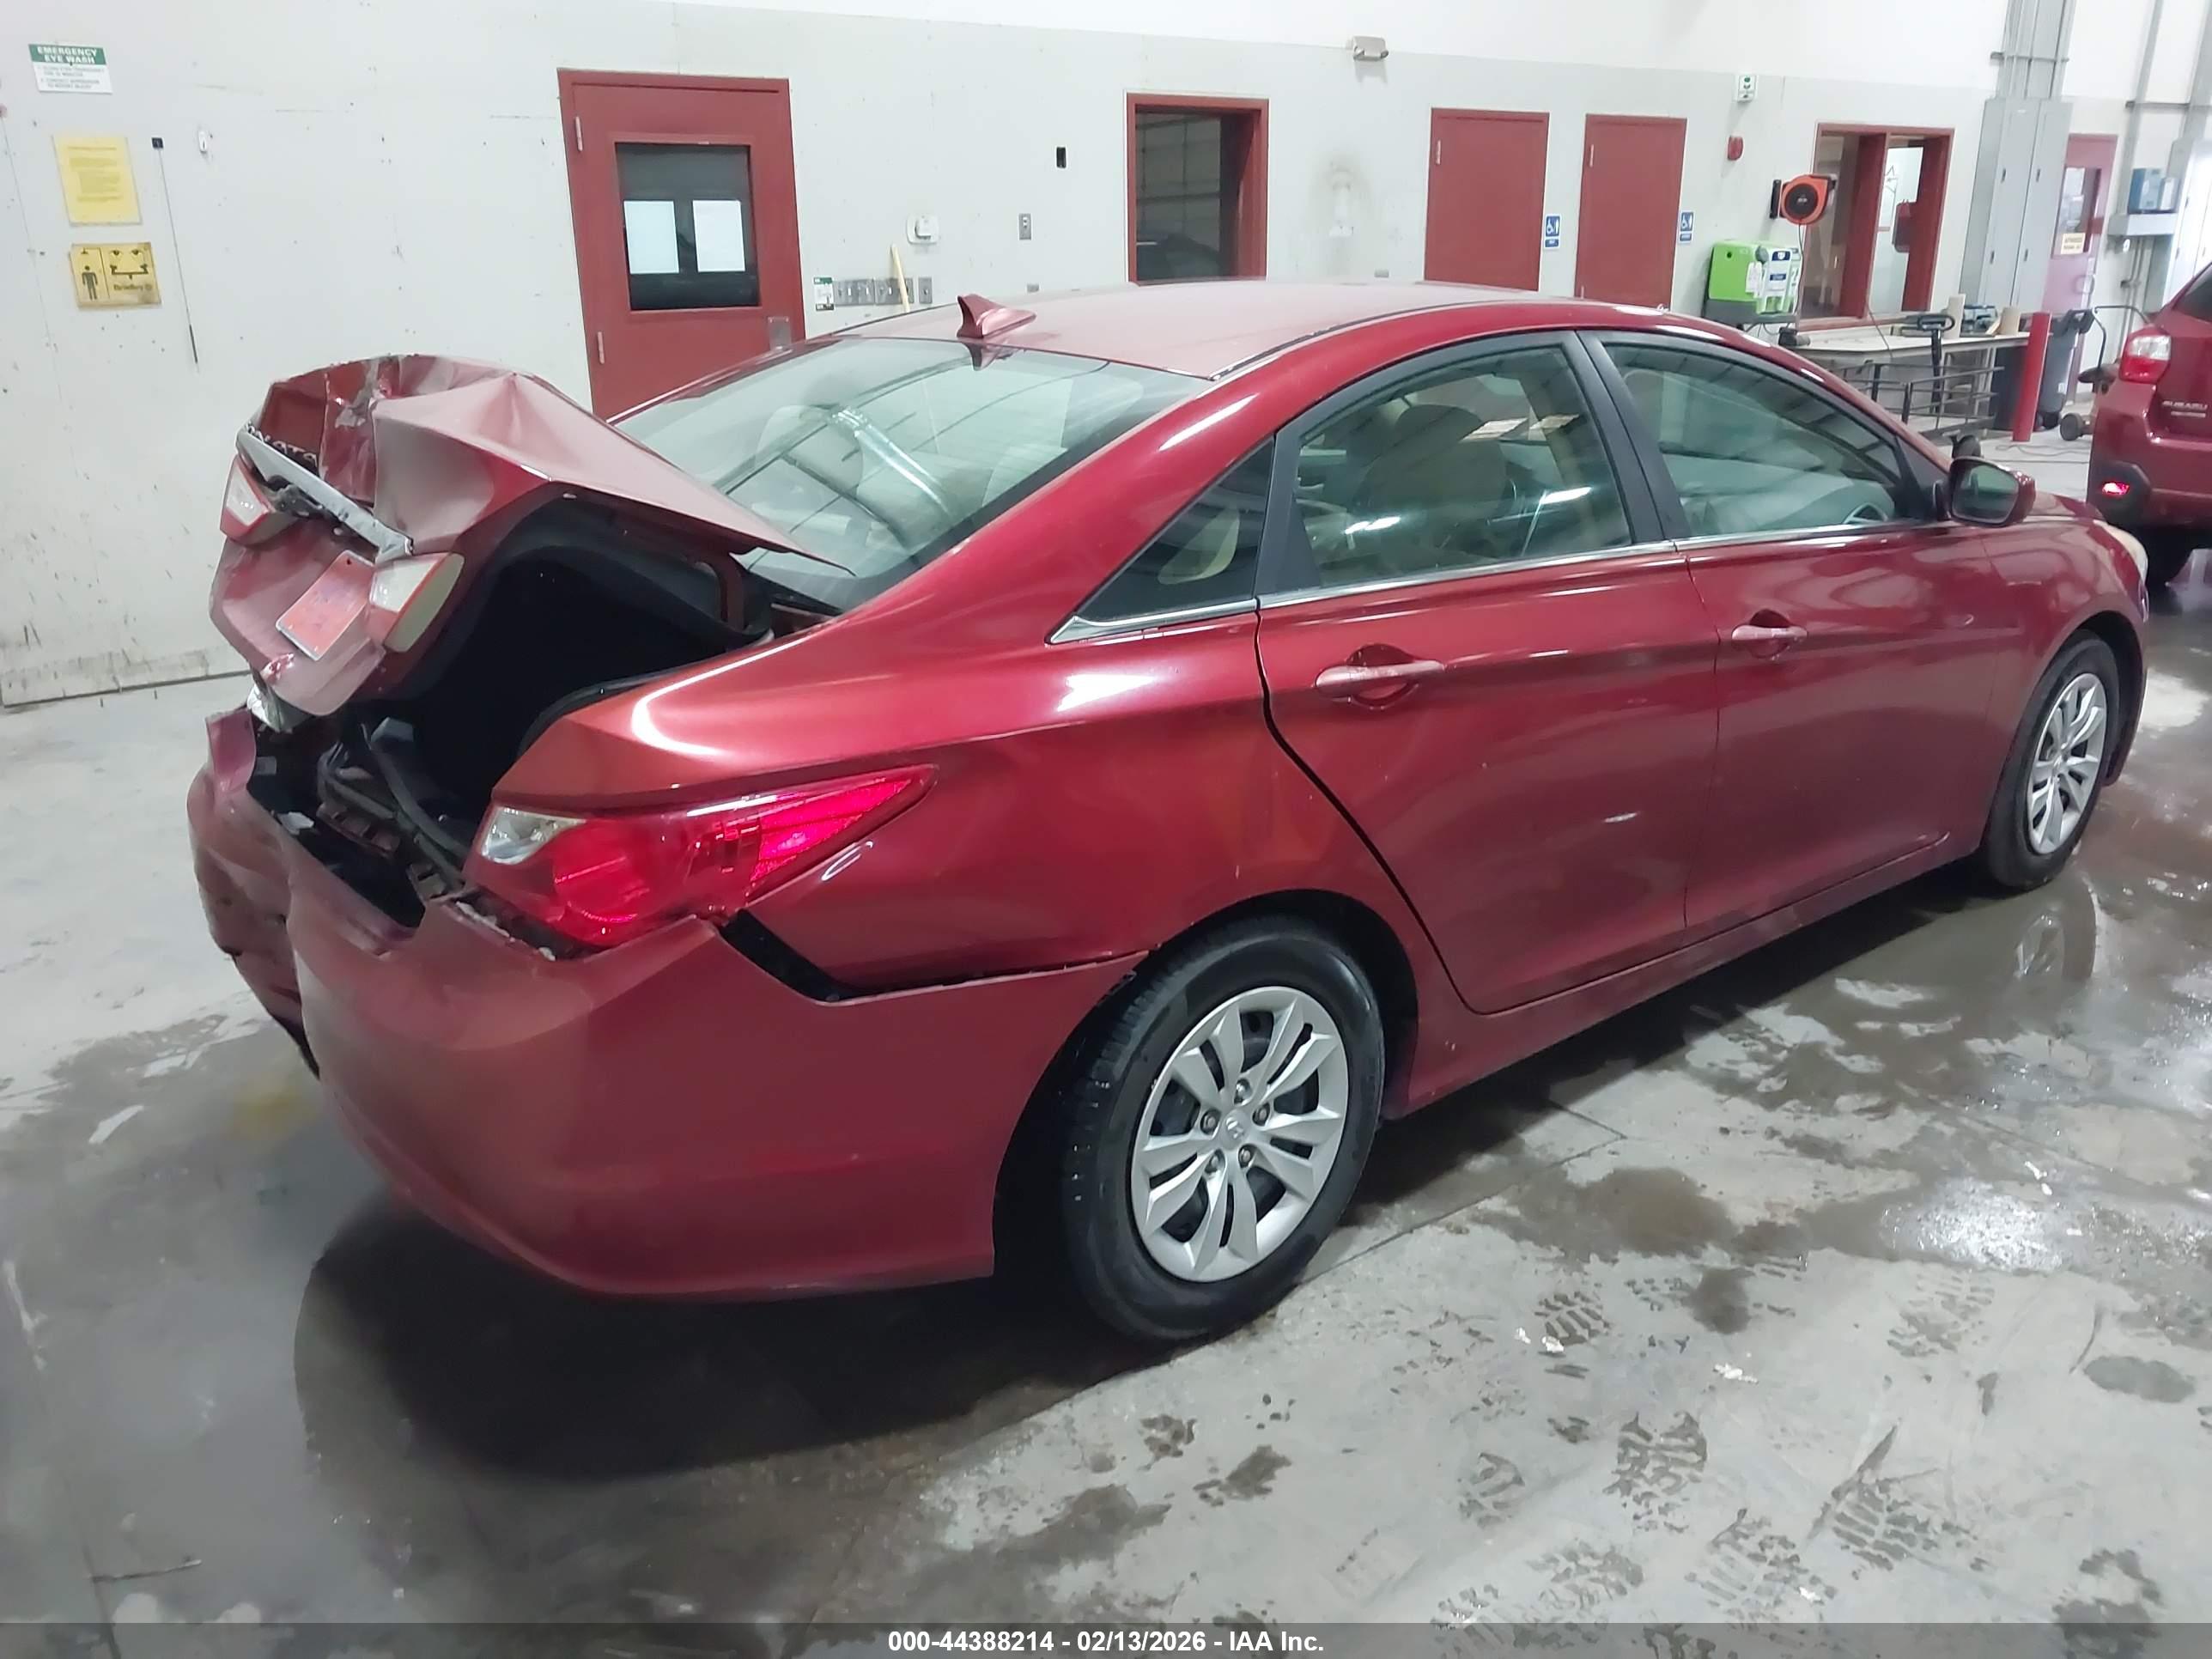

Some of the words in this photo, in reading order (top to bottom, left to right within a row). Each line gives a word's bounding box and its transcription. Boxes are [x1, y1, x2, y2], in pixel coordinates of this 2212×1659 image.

[37, 46, 97, 57] EMERGENCY
[45, 54, 64, 63] EYE
[65, 56, 95, 64] WASH
